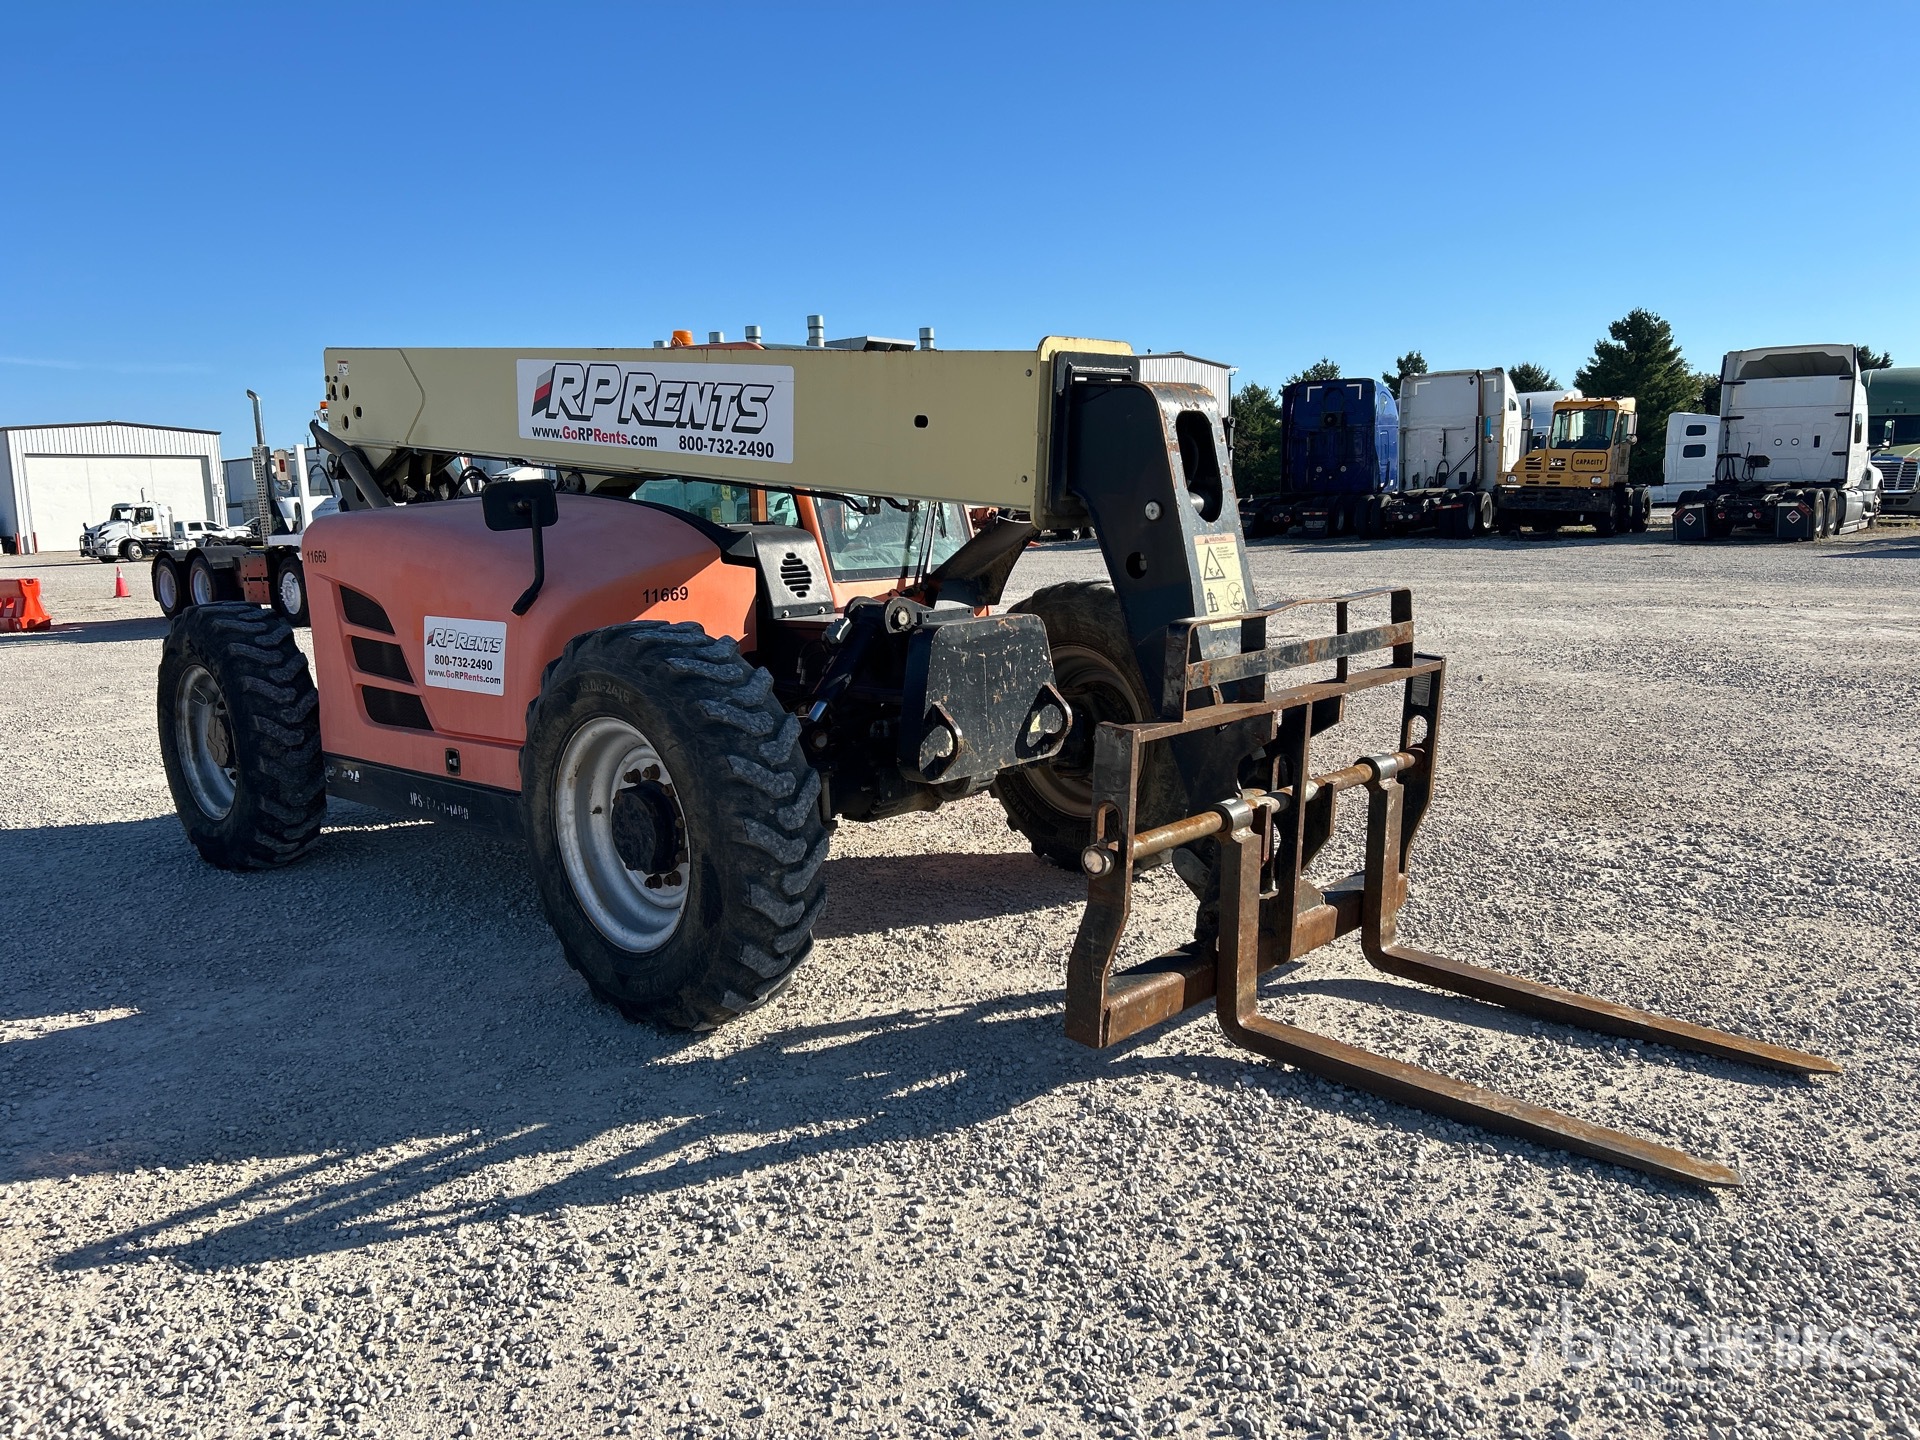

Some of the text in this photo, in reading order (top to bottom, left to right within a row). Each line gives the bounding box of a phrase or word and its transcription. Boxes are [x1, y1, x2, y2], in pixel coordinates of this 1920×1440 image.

[532, 425, 658, 447] www.GoRPRents.com
[679, 435, 775, 458] 800-732-2490
[306, 550, 326, 563] 11669
[642, 586, 689, 603] 11669
[434, 654, 493, 670] 800-732-2490
[427, 669, 501, 684] www.GoRPRents.com
